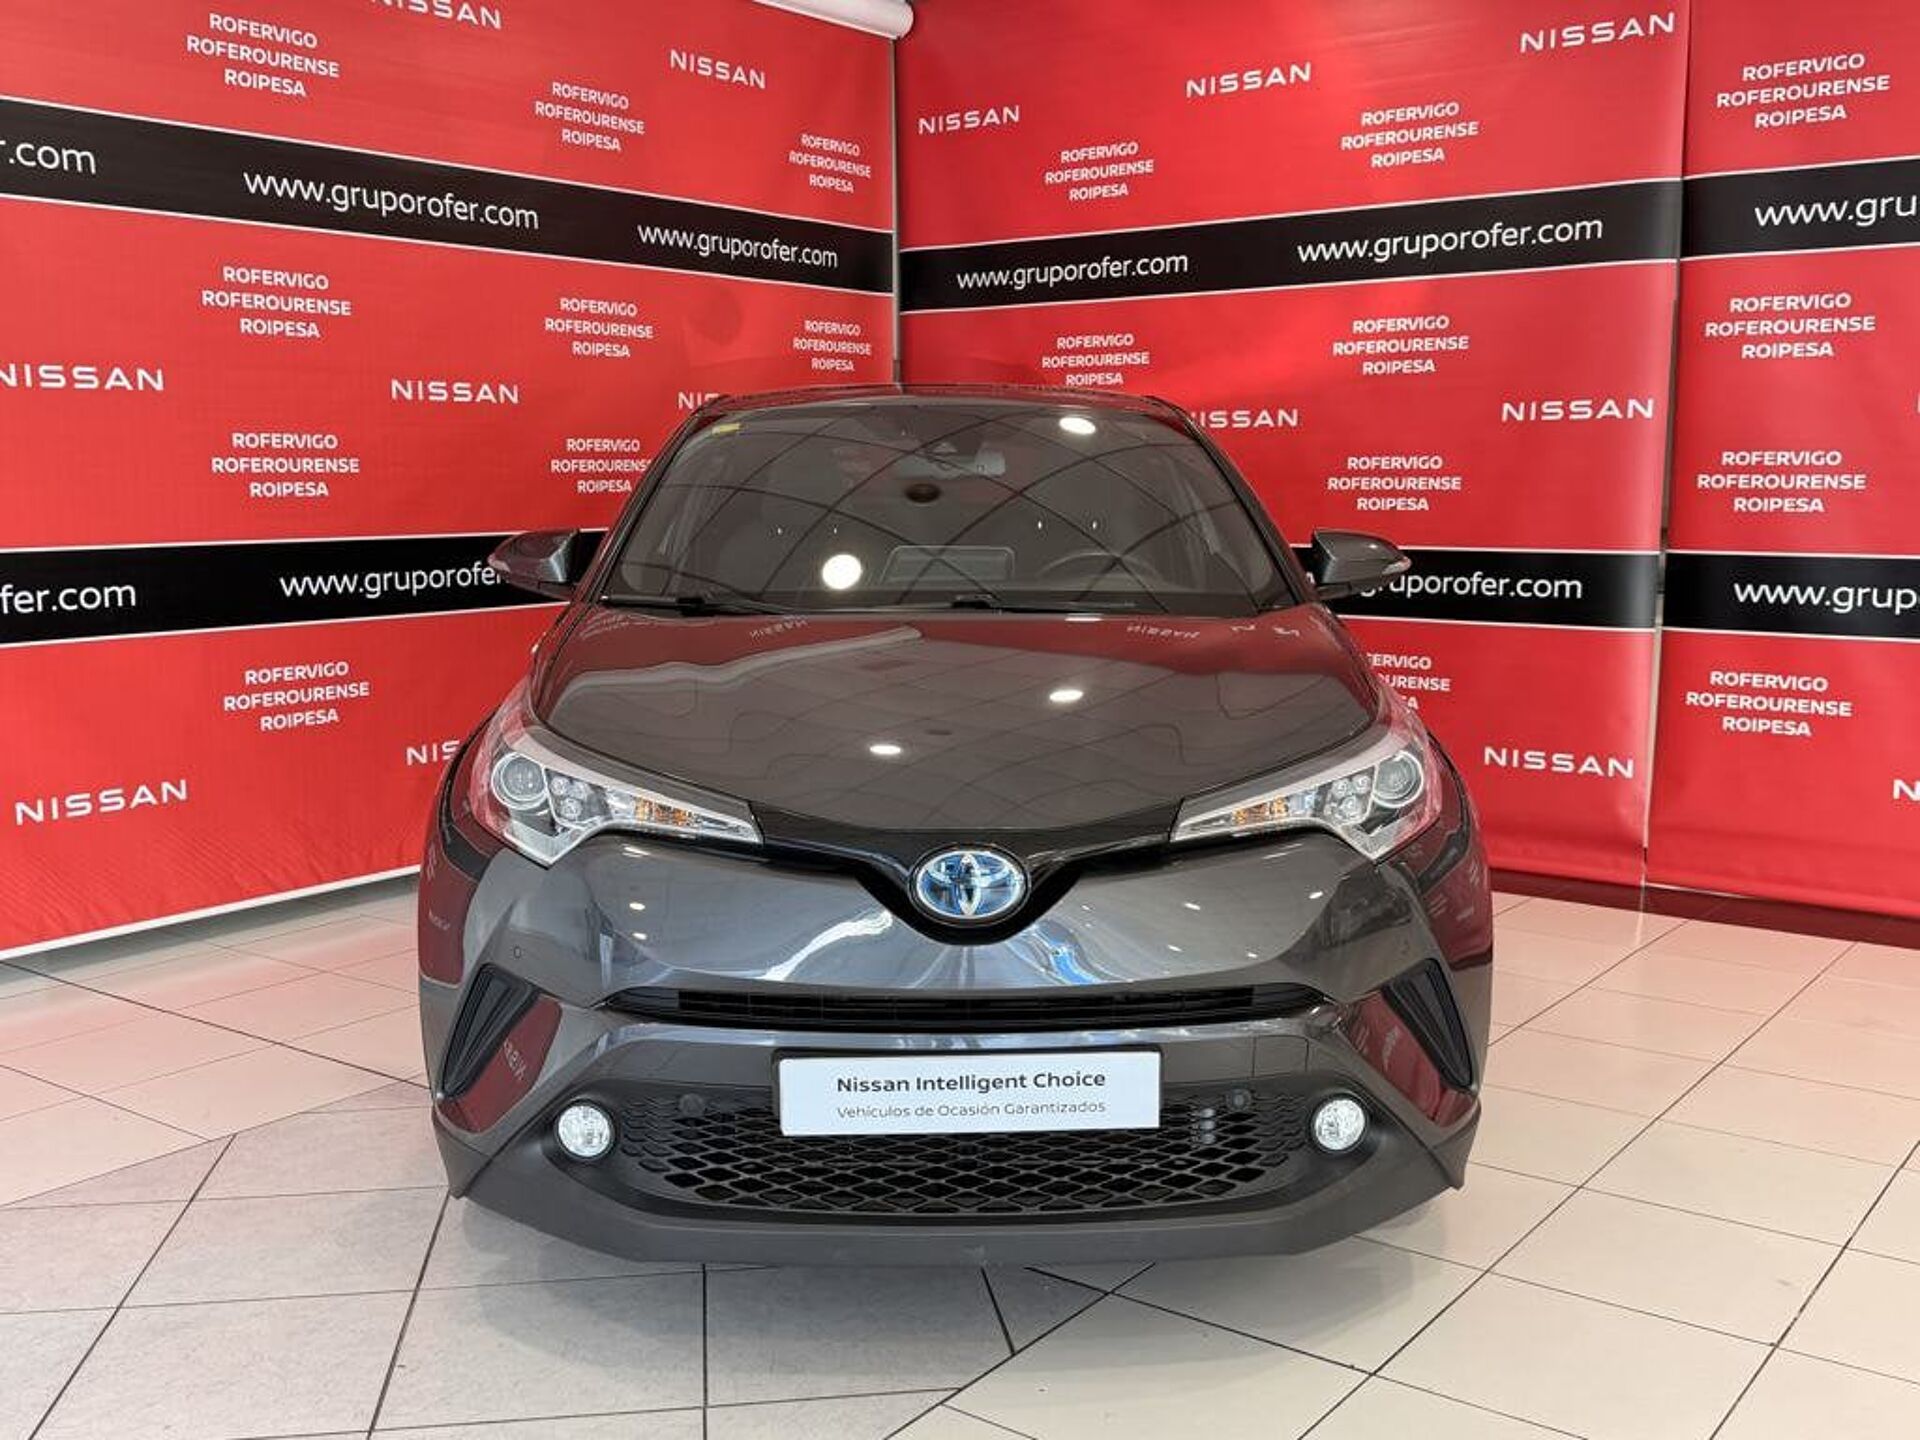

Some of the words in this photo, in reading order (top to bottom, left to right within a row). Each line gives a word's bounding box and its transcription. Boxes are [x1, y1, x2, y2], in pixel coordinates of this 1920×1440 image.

[210, 13, 317, 48] ROFERVIGO
[1521, 12, 1674, 52] NISSAN
[187, 35, 339, 77] ROFEROURENSE
[1743, 53, 1865, 81] ROFERVIGO
[671, 49, 765, 89] NISSAN
[1186, 62, 1311, 97] NISSAN
[225, 69, 306, 97] ROIPESA
[1717, 75, 1890, 108] ROFEROURENSE
[553, 82, 629, 109] ROFERVIGO
[535, 101, 645, 134] ROFEROURENSE
[919, 105, 1019, 134] NISSAN
[1361, 102, 1459, 125] ROFERVIGO
[1755, 105, 1847, 128] ROIPESA
[562, 129, 621, 151] ROIPESA
[801, 134, 860, 156] ROFERVIGO
[1341, 121, 1478, 150] ROFEROURENSE
[1061, 141, 1138, 163] ROFERVIGO
[1371, 148, 1445, 168] ROIPESA
[789, 151, 870, 178] ROFEROURENSE
[1045, 159, 1154, 184] ROFEROURENSE
[810, 174, 853, 193] ROIPESA
[1069, 183, 1128, 201] ROIPESA
[243, 172, 538, 229] www.gruporofer.com
[1755, 195, 1917, 227] www.gru
[637, 225, 837, 268] www.gruporofer.com
[1297, 220, 1603, 263] www.gruporofer.com
[223, 266, 328, 289] ROFERVIGO
[956, 255, 1188, 290] www.gruporofer.com
[202, 290, 351, 315] ROFEROURENSE
[560, 298, 637, 317] ROFERVIGO
[1730, 293, 1851, 312] ROFERVIGO
[240, 318, 320, 338] ROIPESA
[545, 318, 653, 338] ROFEROURENSE
[805, 320, 860, 336] ROFERVIGO
[1353, 315, 1449, 333] ROFERVIGO
[1705, 316, 1875, 337] ROFEROURENSE
[572, 341, 630, 357] ROIPESA
[793, 337, 871, 355] ROFEROURENSE
[1057, 333, 1134, 349] ROFERVIGO
[1333, 336, 1469, 355] ROFEROURENSE
[1742, 342, 1834, 358] ROIPESA
[812, 358, 854, 371] ROIPESA
[1042, 352, 1149, 368] ROFEROURENSE
[1363, 359, 1436, 375] ROIPESA
[392, 379, 518, 404] NISSAN
[1066, 373, 1123, 388] ROIPESA
[1191, 409, 1298, 428] ISSAN
[1502, 399, 1654, 422] NISSAN
[232, 433, 338, 449] ROFERVIGO
[567, 438, 640, 452] ROFERVIGO
[212, 457, 360, 473] ROFEROURENSE
[551, 459, 651, 473] ROFEROURENS
[1347, 456, 1443, 469] ROFERVIGO
[1722, 451, 1842, 465] ROFERVIGO
[249, 482, 329, 497] ROIPESA
[577, 480, 632, 493] ROIPESA
[1327, 476, 1462, 490] ROFEROURENSE
[1697, 474, 1866, 490] ROFEROURENSE
[1357, 497, 1429, 510] ROIPESA
[1734, 497, 1824, 512] ROIPESA
[0, 584, 136, 614] fer.com
[1734, 583, 1920, 615] www.grup
[245, 662, 349, 684] ROFERVIGO
[1379, 674, 1451, 692] URENSE
[1710, 671, 1828, 692] ROFERVIGO
[224, 682, 369, 711] ROFEROURENSE
[1685, 691, 1852, 717] ROFEROURENSE
[260, 709, 339, 731] ROIPESA
[1722, 716, 1811, 736] ROIPESA
[1484, 746, 1633, 778] NISSAN
[15, 779, 187, 825] NISSAN
[837, 1077, 910, 1093] Nissan
[916, 1074, 1028, 1094] Intelligent
[1033, 1070, 1105, 1089] Choice
[914, 1105, 934, 1117] de
[937, 1102, 1000, 1117] Ocasión
[1004, 1101, 1106, 1116] Garantizados
